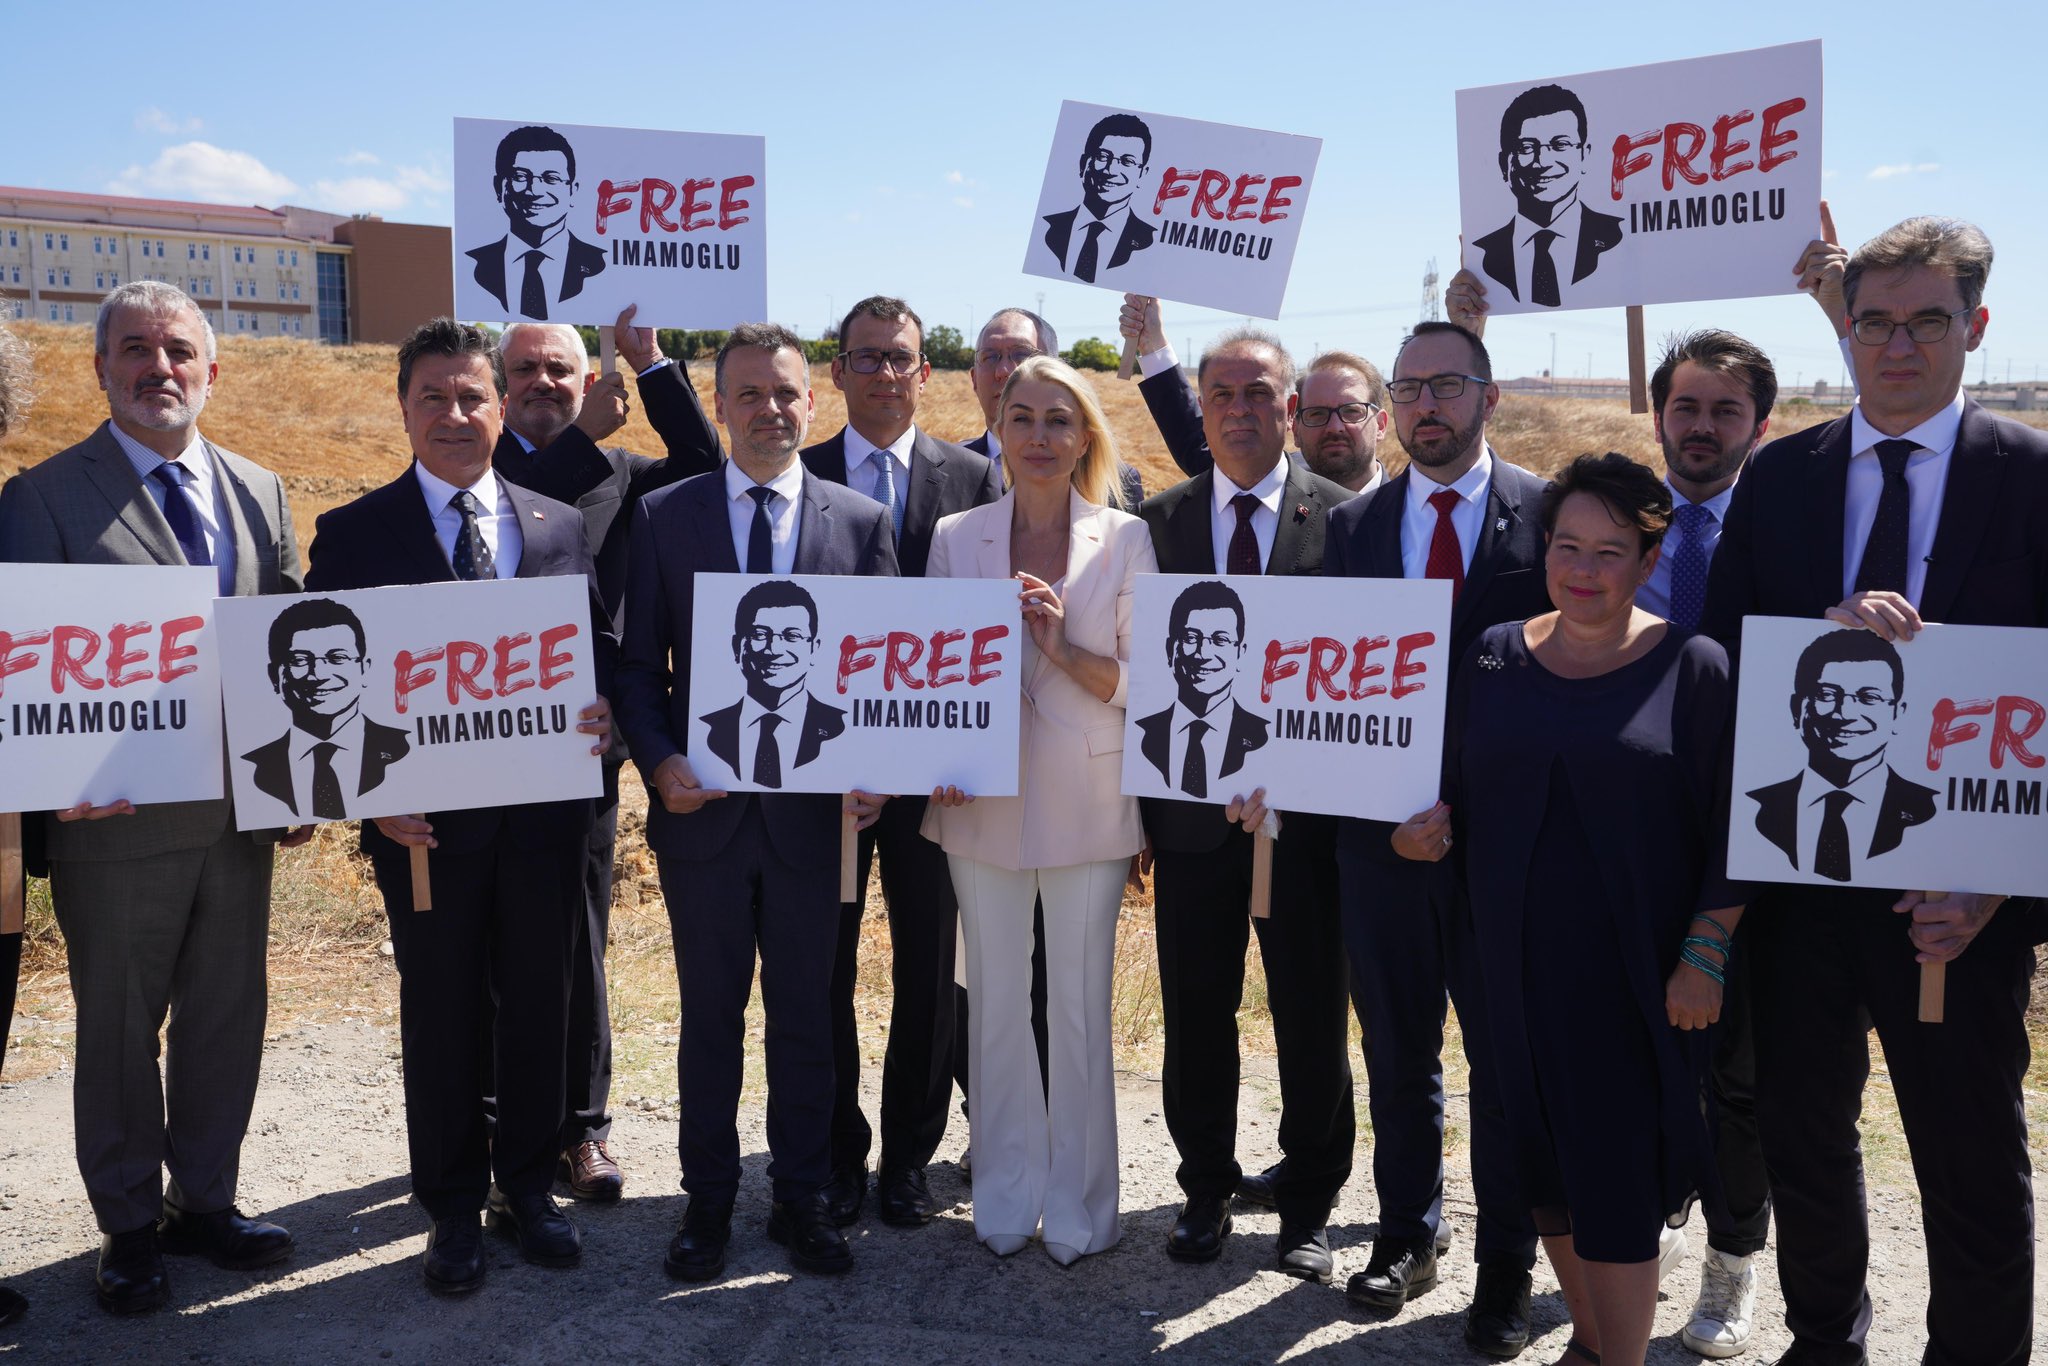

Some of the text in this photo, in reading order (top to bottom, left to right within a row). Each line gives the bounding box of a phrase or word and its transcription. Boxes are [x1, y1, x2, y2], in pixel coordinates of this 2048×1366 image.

[1611, 97, 1805, 200] FREE
[597, 175, 755, 234] FREE
[1154, 167, 1301, 223] FREE
[1630, 187, 1785, 233] IMAMOGLU
[612, 239, 740, 271] IMAMOGLU
[1160, 219, 1273, 260] IMAMOGLU
[0, 615, 205, 698] FREE
[393, 623, 579, 714] FREE
[837, 625, 1009, 694] FREE
[1260, 631, 1436, 703] FREE
[12, 699, 186, 736] IMAMOGLU
[416, 703, 567, 746] IMAMOGLU
[853, 698, 990, 730] IMAMOGLU
[1275, 708, 1412, 749] IMAMOGLU
[1946, 776, 2048, 816] IMAM
